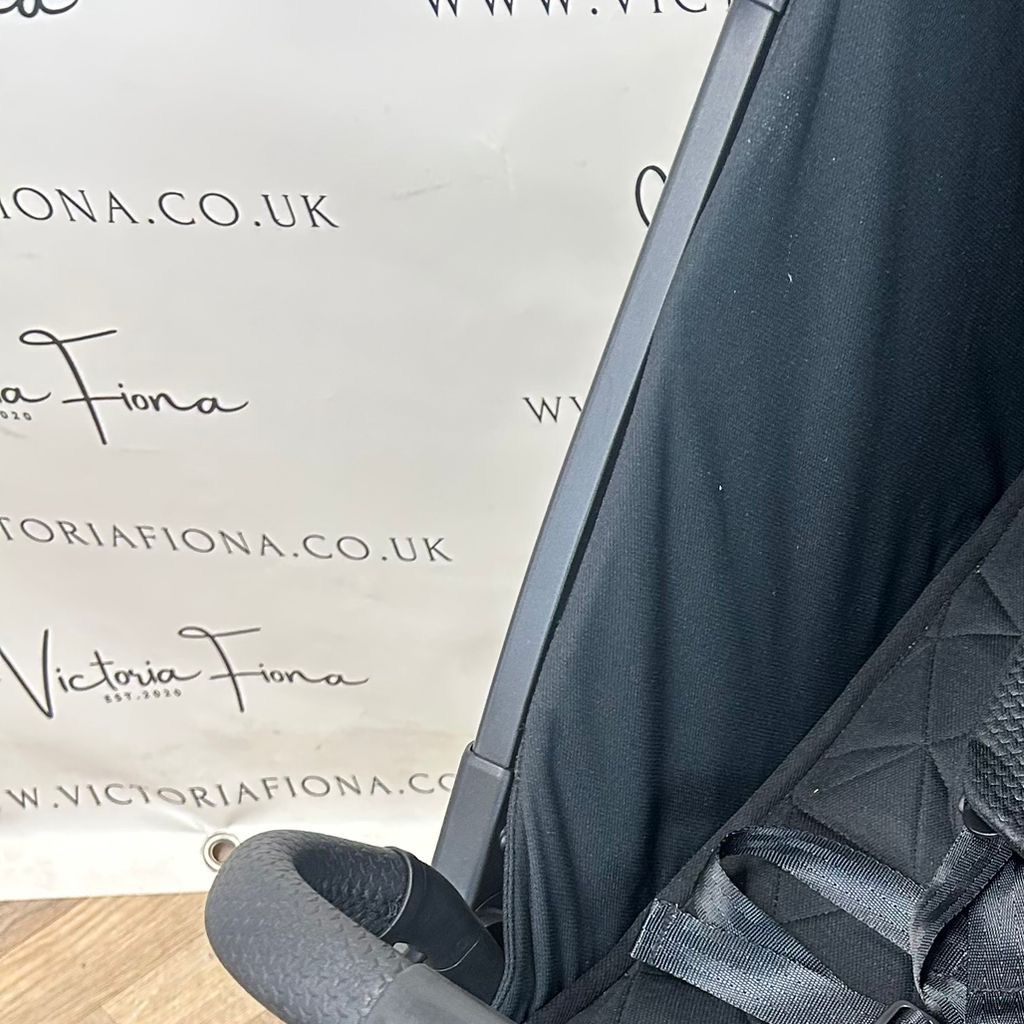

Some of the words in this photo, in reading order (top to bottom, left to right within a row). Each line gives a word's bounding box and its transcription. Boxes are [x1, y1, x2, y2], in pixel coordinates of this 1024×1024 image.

[19, 329, 249, 445] Fiona
[0, 628, 202, 719] Victoria
[178, 626, 370, 713] Fiona
